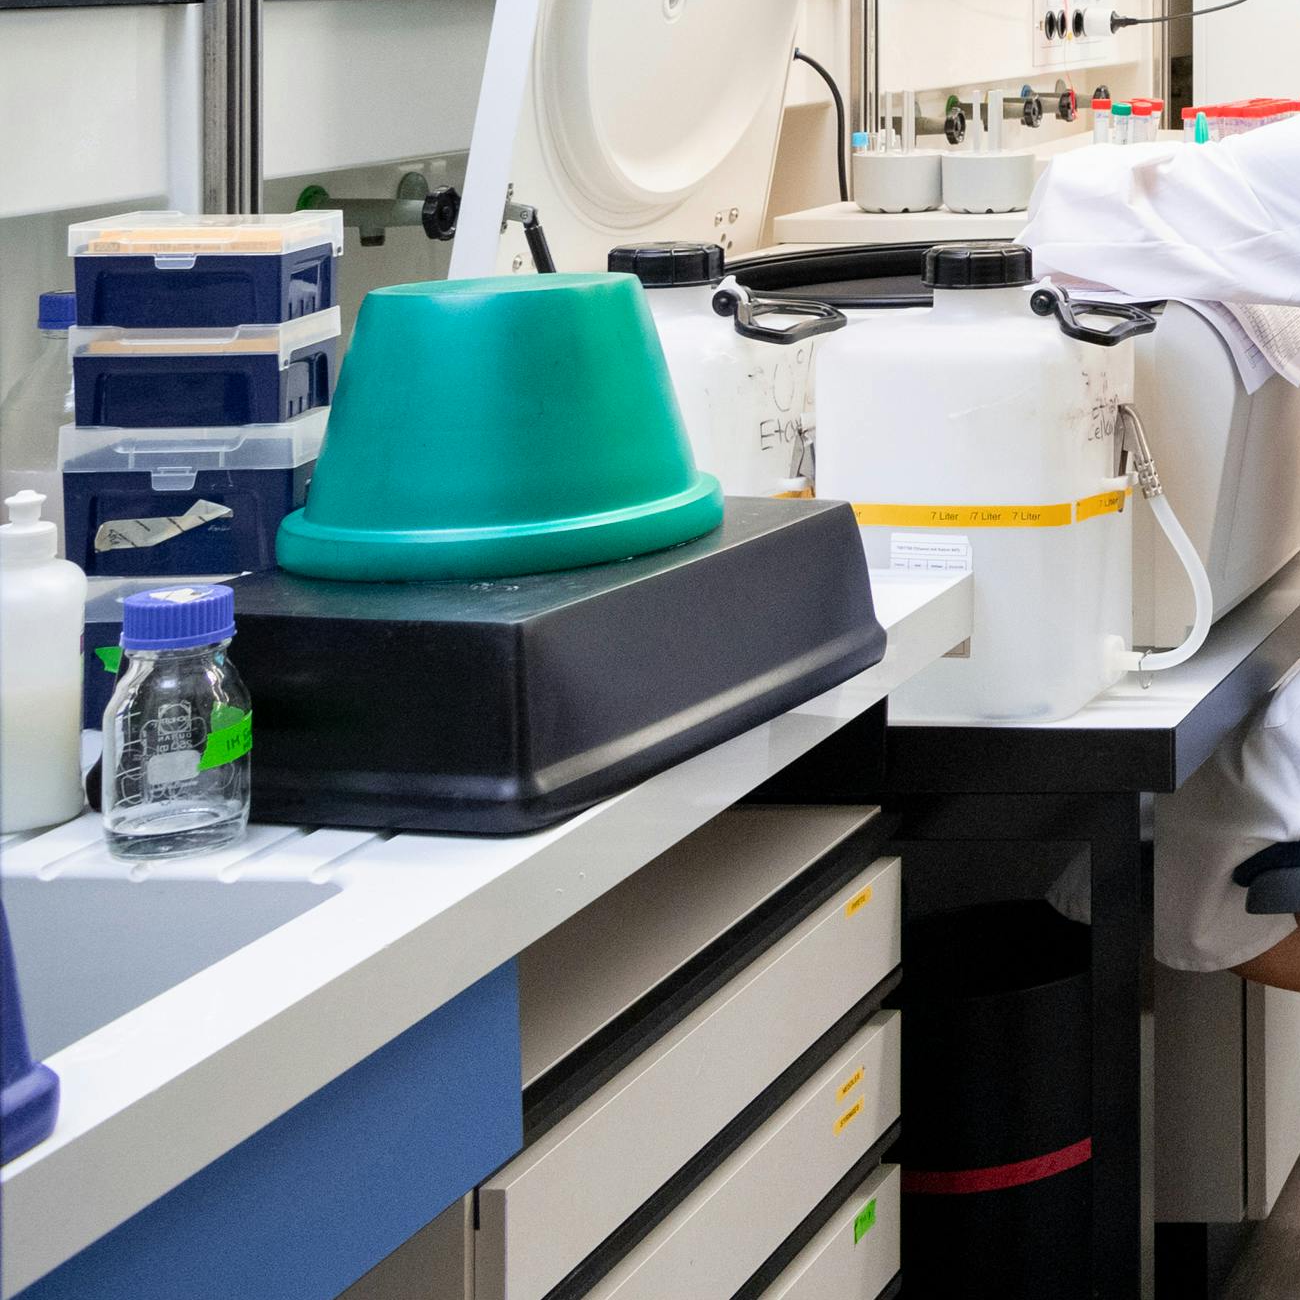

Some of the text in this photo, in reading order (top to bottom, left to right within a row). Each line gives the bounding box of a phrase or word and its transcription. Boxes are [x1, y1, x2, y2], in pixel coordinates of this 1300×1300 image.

[939, 511, 959, 521] Liter
[981, 511, 1001, 521] Liter
[1012, 511, 1019, 521] 7
[1020, 511, 1041, 521] Liter
